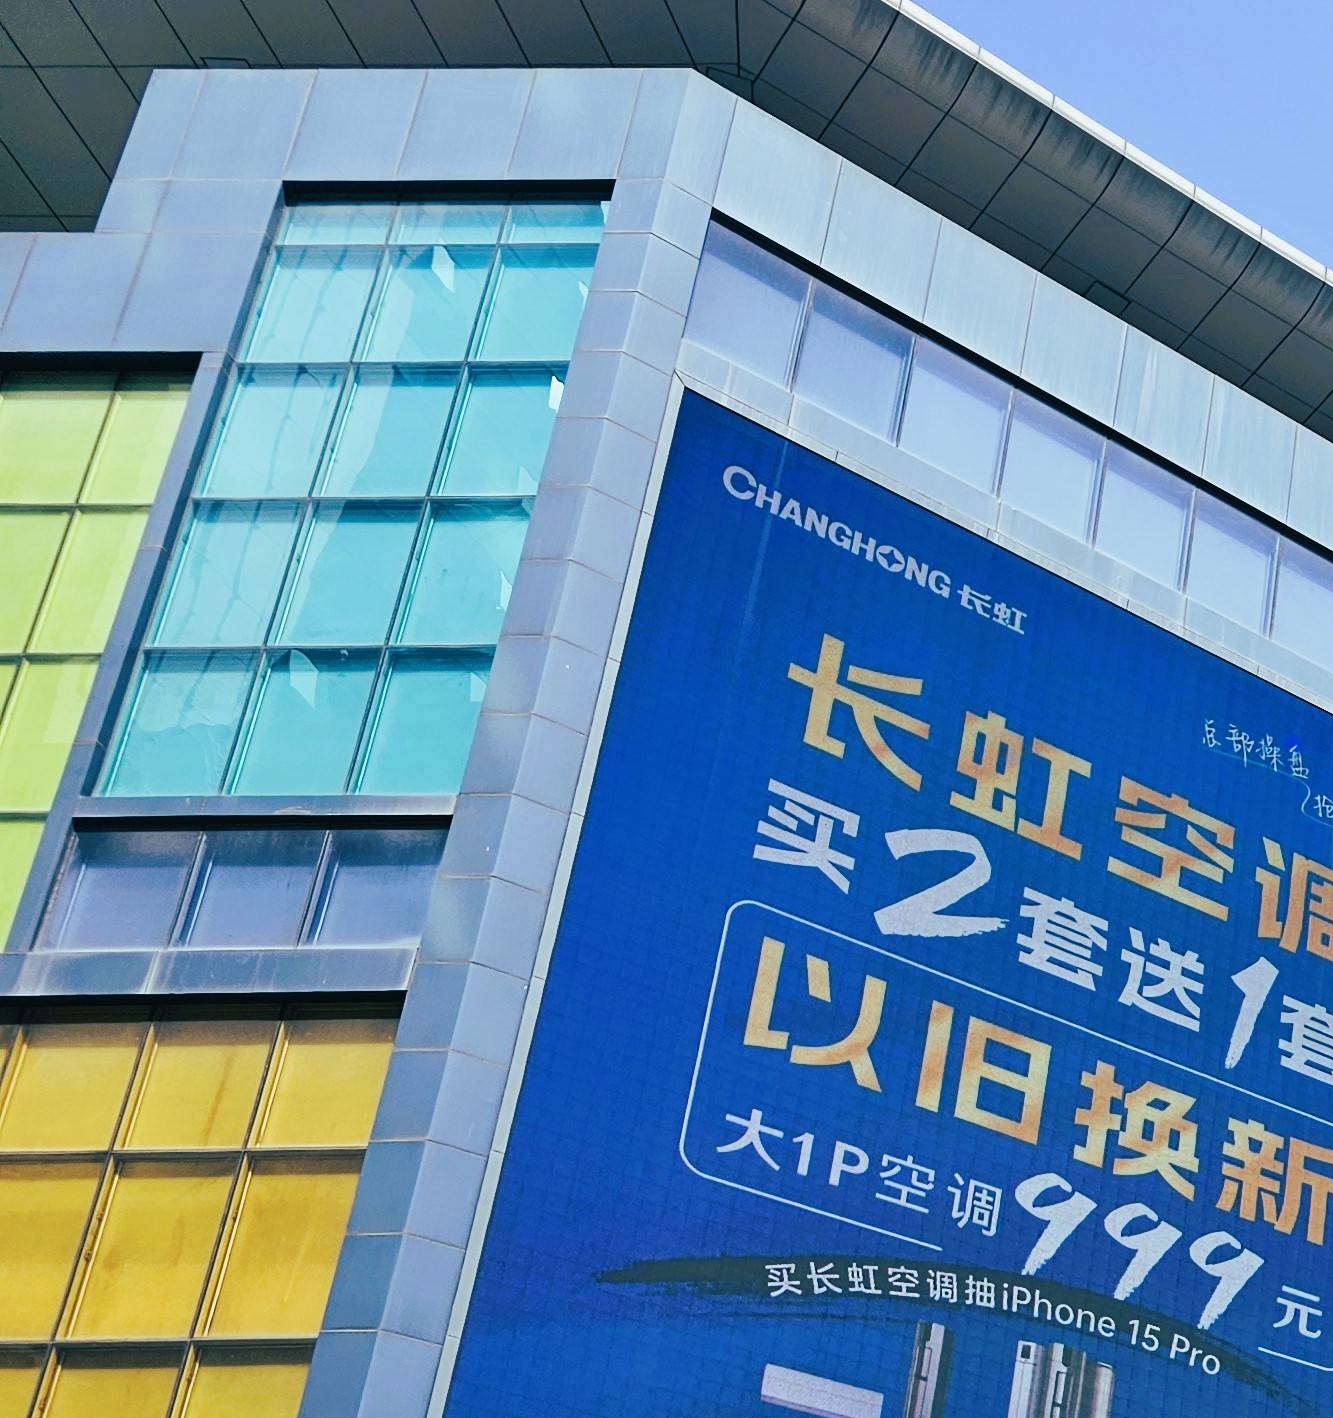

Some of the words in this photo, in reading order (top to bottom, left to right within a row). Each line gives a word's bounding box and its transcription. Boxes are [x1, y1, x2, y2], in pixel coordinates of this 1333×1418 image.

[722, 464, 952, 598] CHANGHONG
[957, 583, 1028, 635] 长虹
[1127, 1316, 1161, 1353] 15
[1170, 1329, 1222, 1377] Pro
